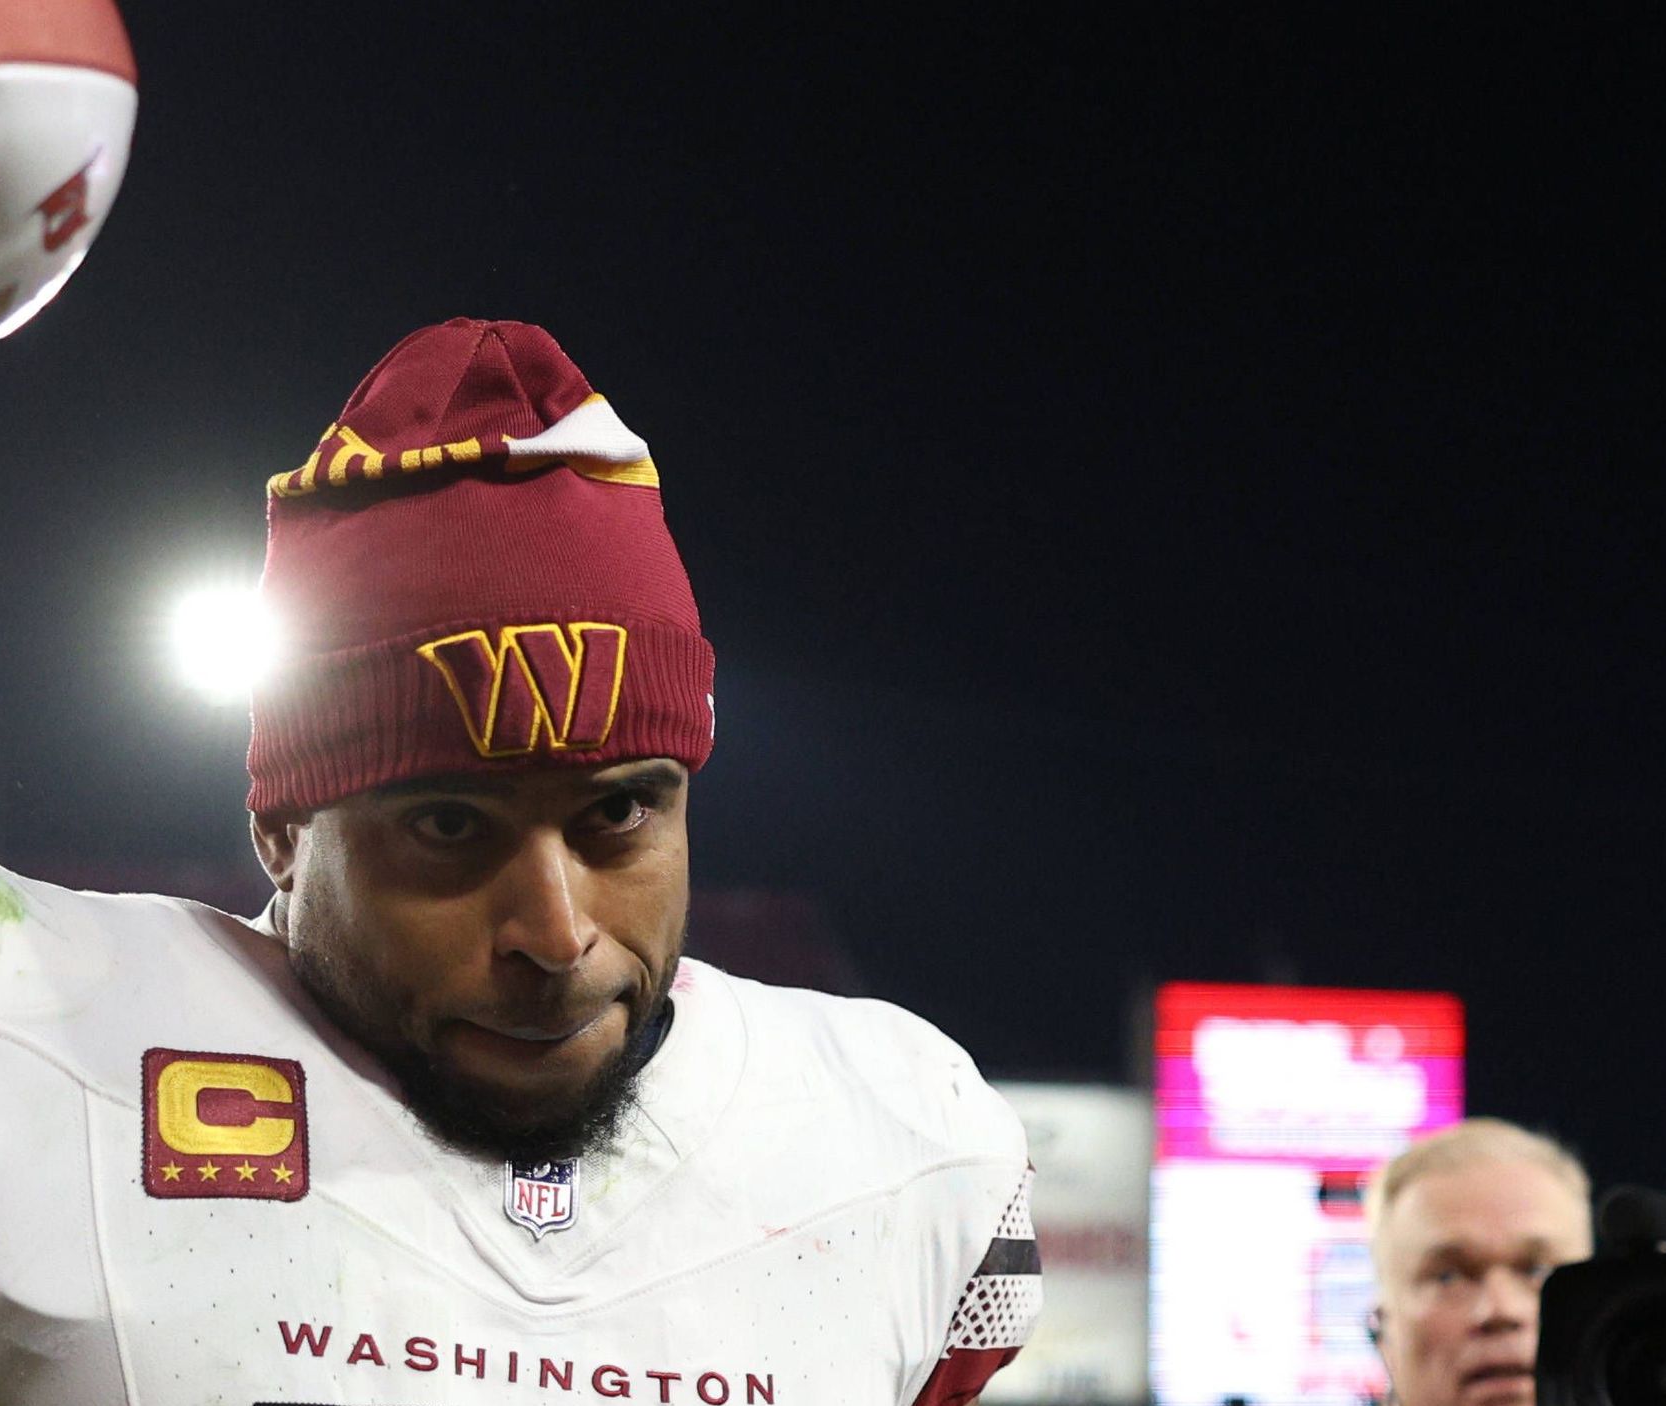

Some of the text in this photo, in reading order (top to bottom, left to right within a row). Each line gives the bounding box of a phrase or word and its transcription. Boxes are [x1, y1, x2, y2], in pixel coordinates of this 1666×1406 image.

[416, 622, 627, 758] W
[155, 1059, 297, 1158] C
[517, 1181, 566, 1219] NFL
[277, 1320, 777, 1406] WASHINGTON
